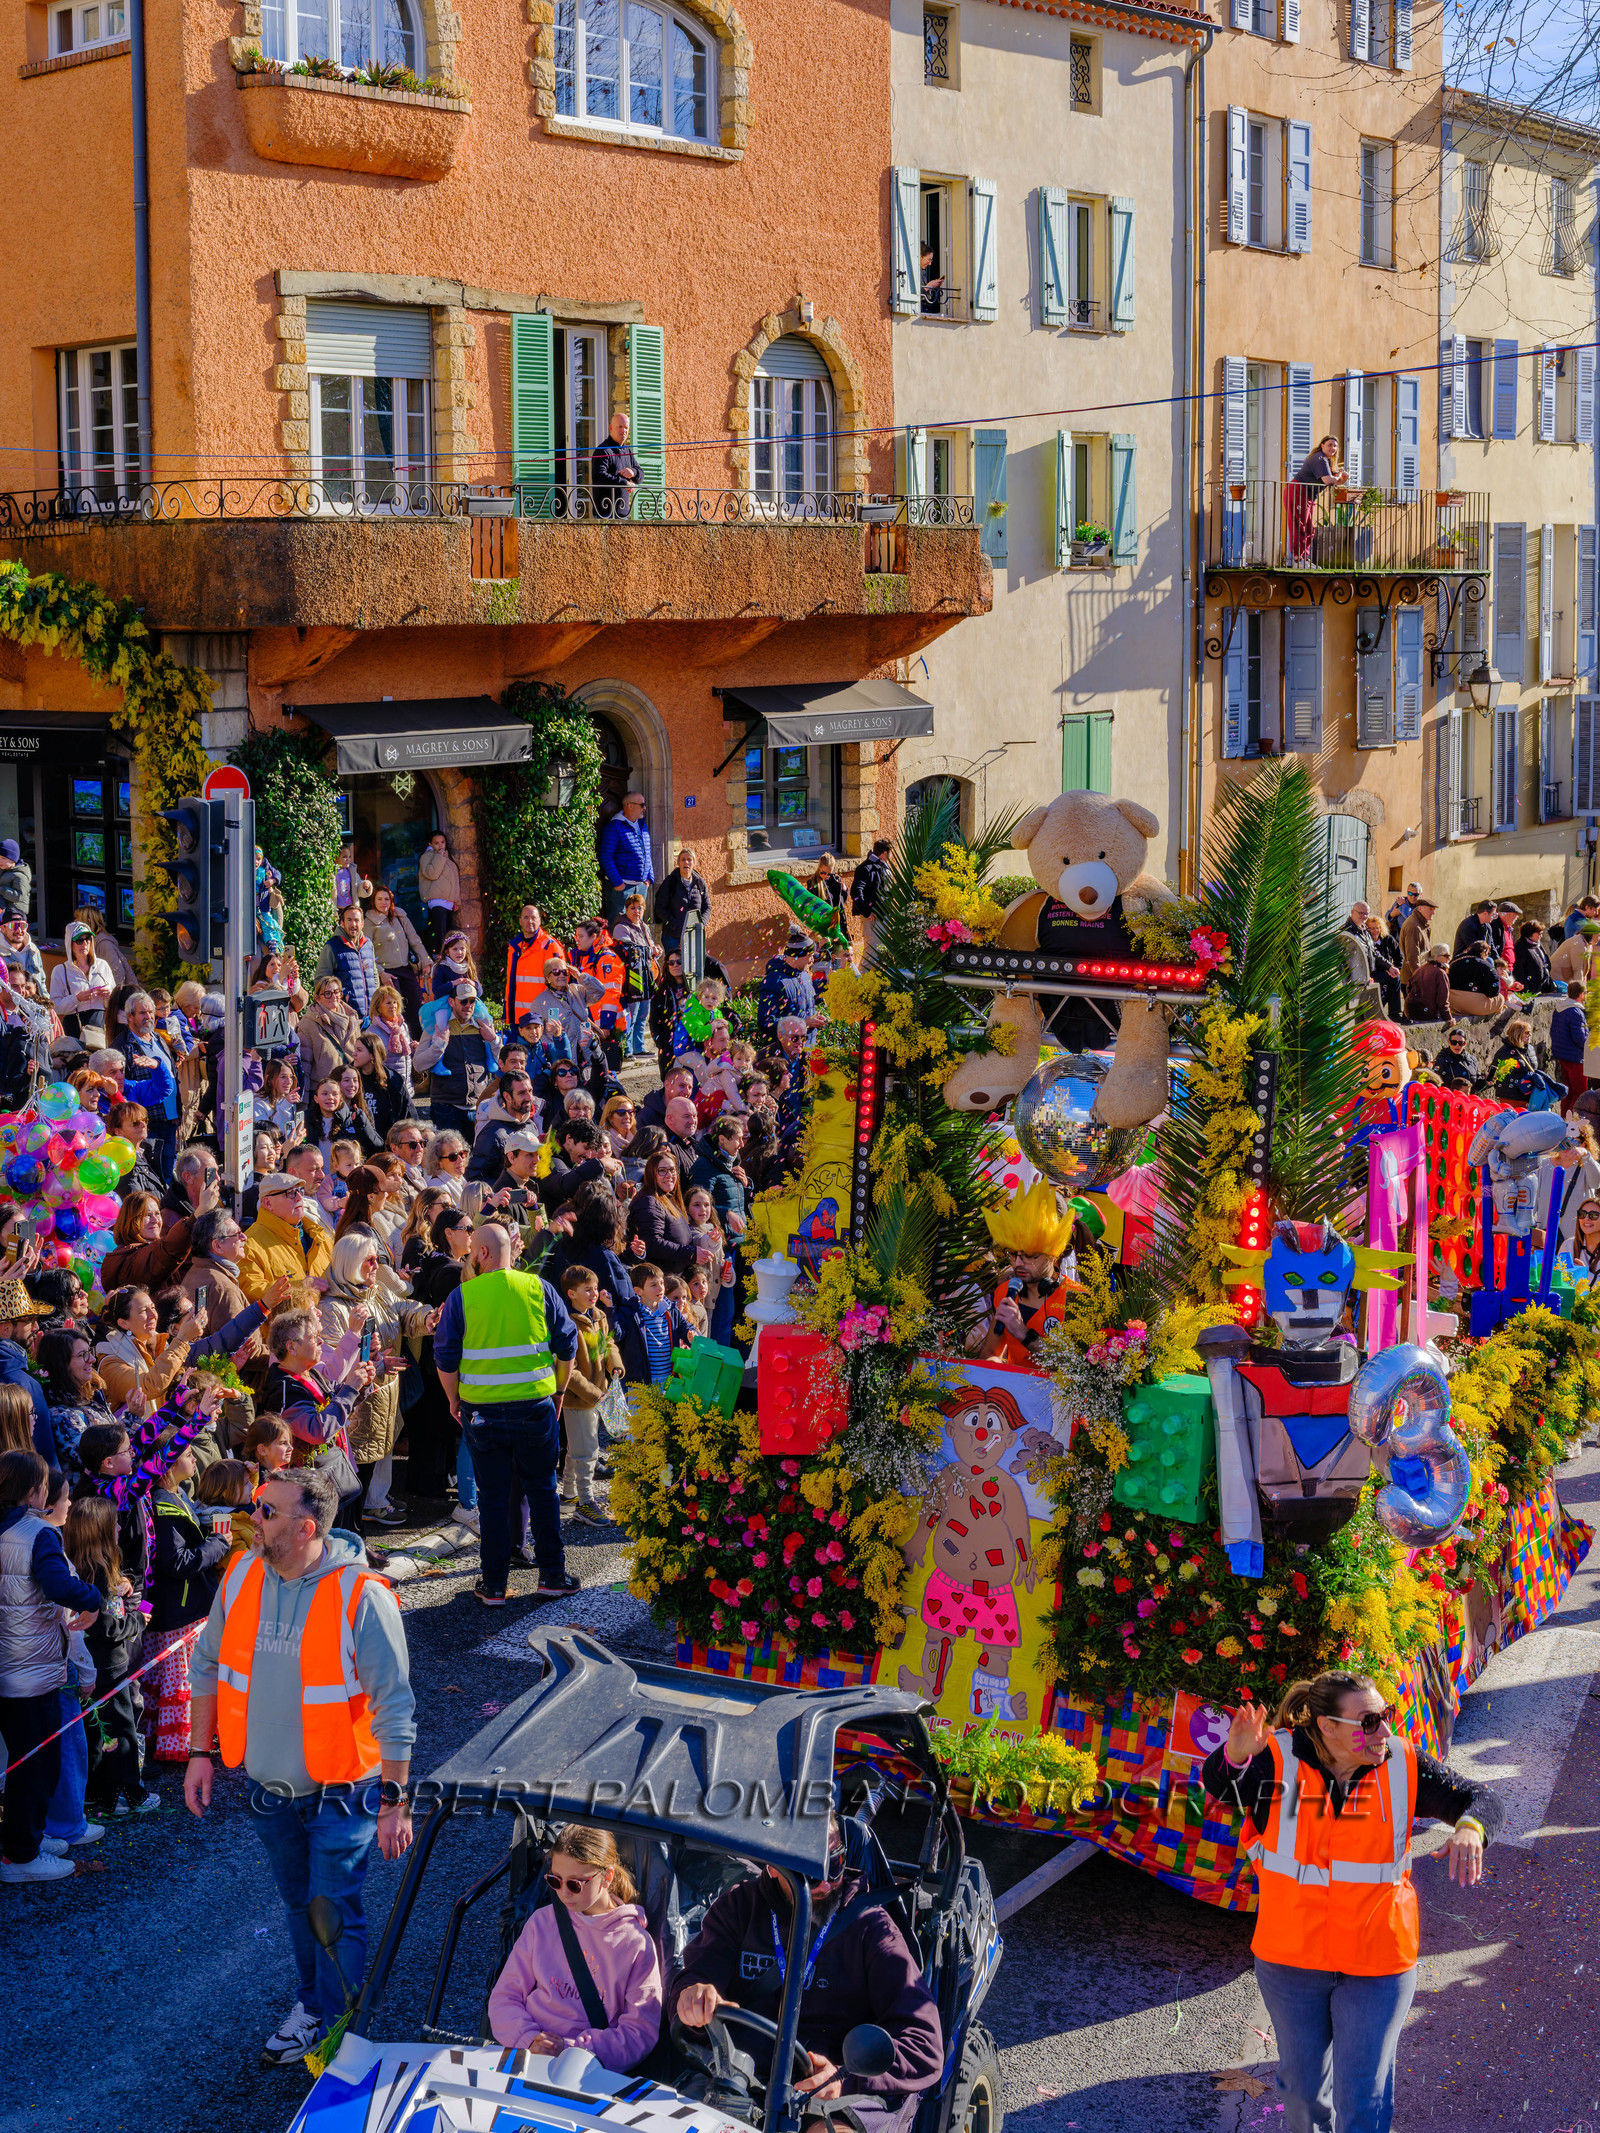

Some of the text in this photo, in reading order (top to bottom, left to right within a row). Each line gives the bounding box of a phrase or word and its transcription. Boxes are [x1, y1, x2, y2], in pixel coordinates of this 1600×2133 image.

[829, 717, 892, 730] MAGREY & SONS
[10, 736, 16, 748] &
[18, 737, 40, 749] SONS
[405, 738, 489, 754] MAGREY & SONS
[1047, 911, 1074, 919] RESTENT
[258, 1620, 305, 1641] TEDDY
[254, 1636, 301, 1659] SMITH
[1196, 1706, 1232, 1754] 3
